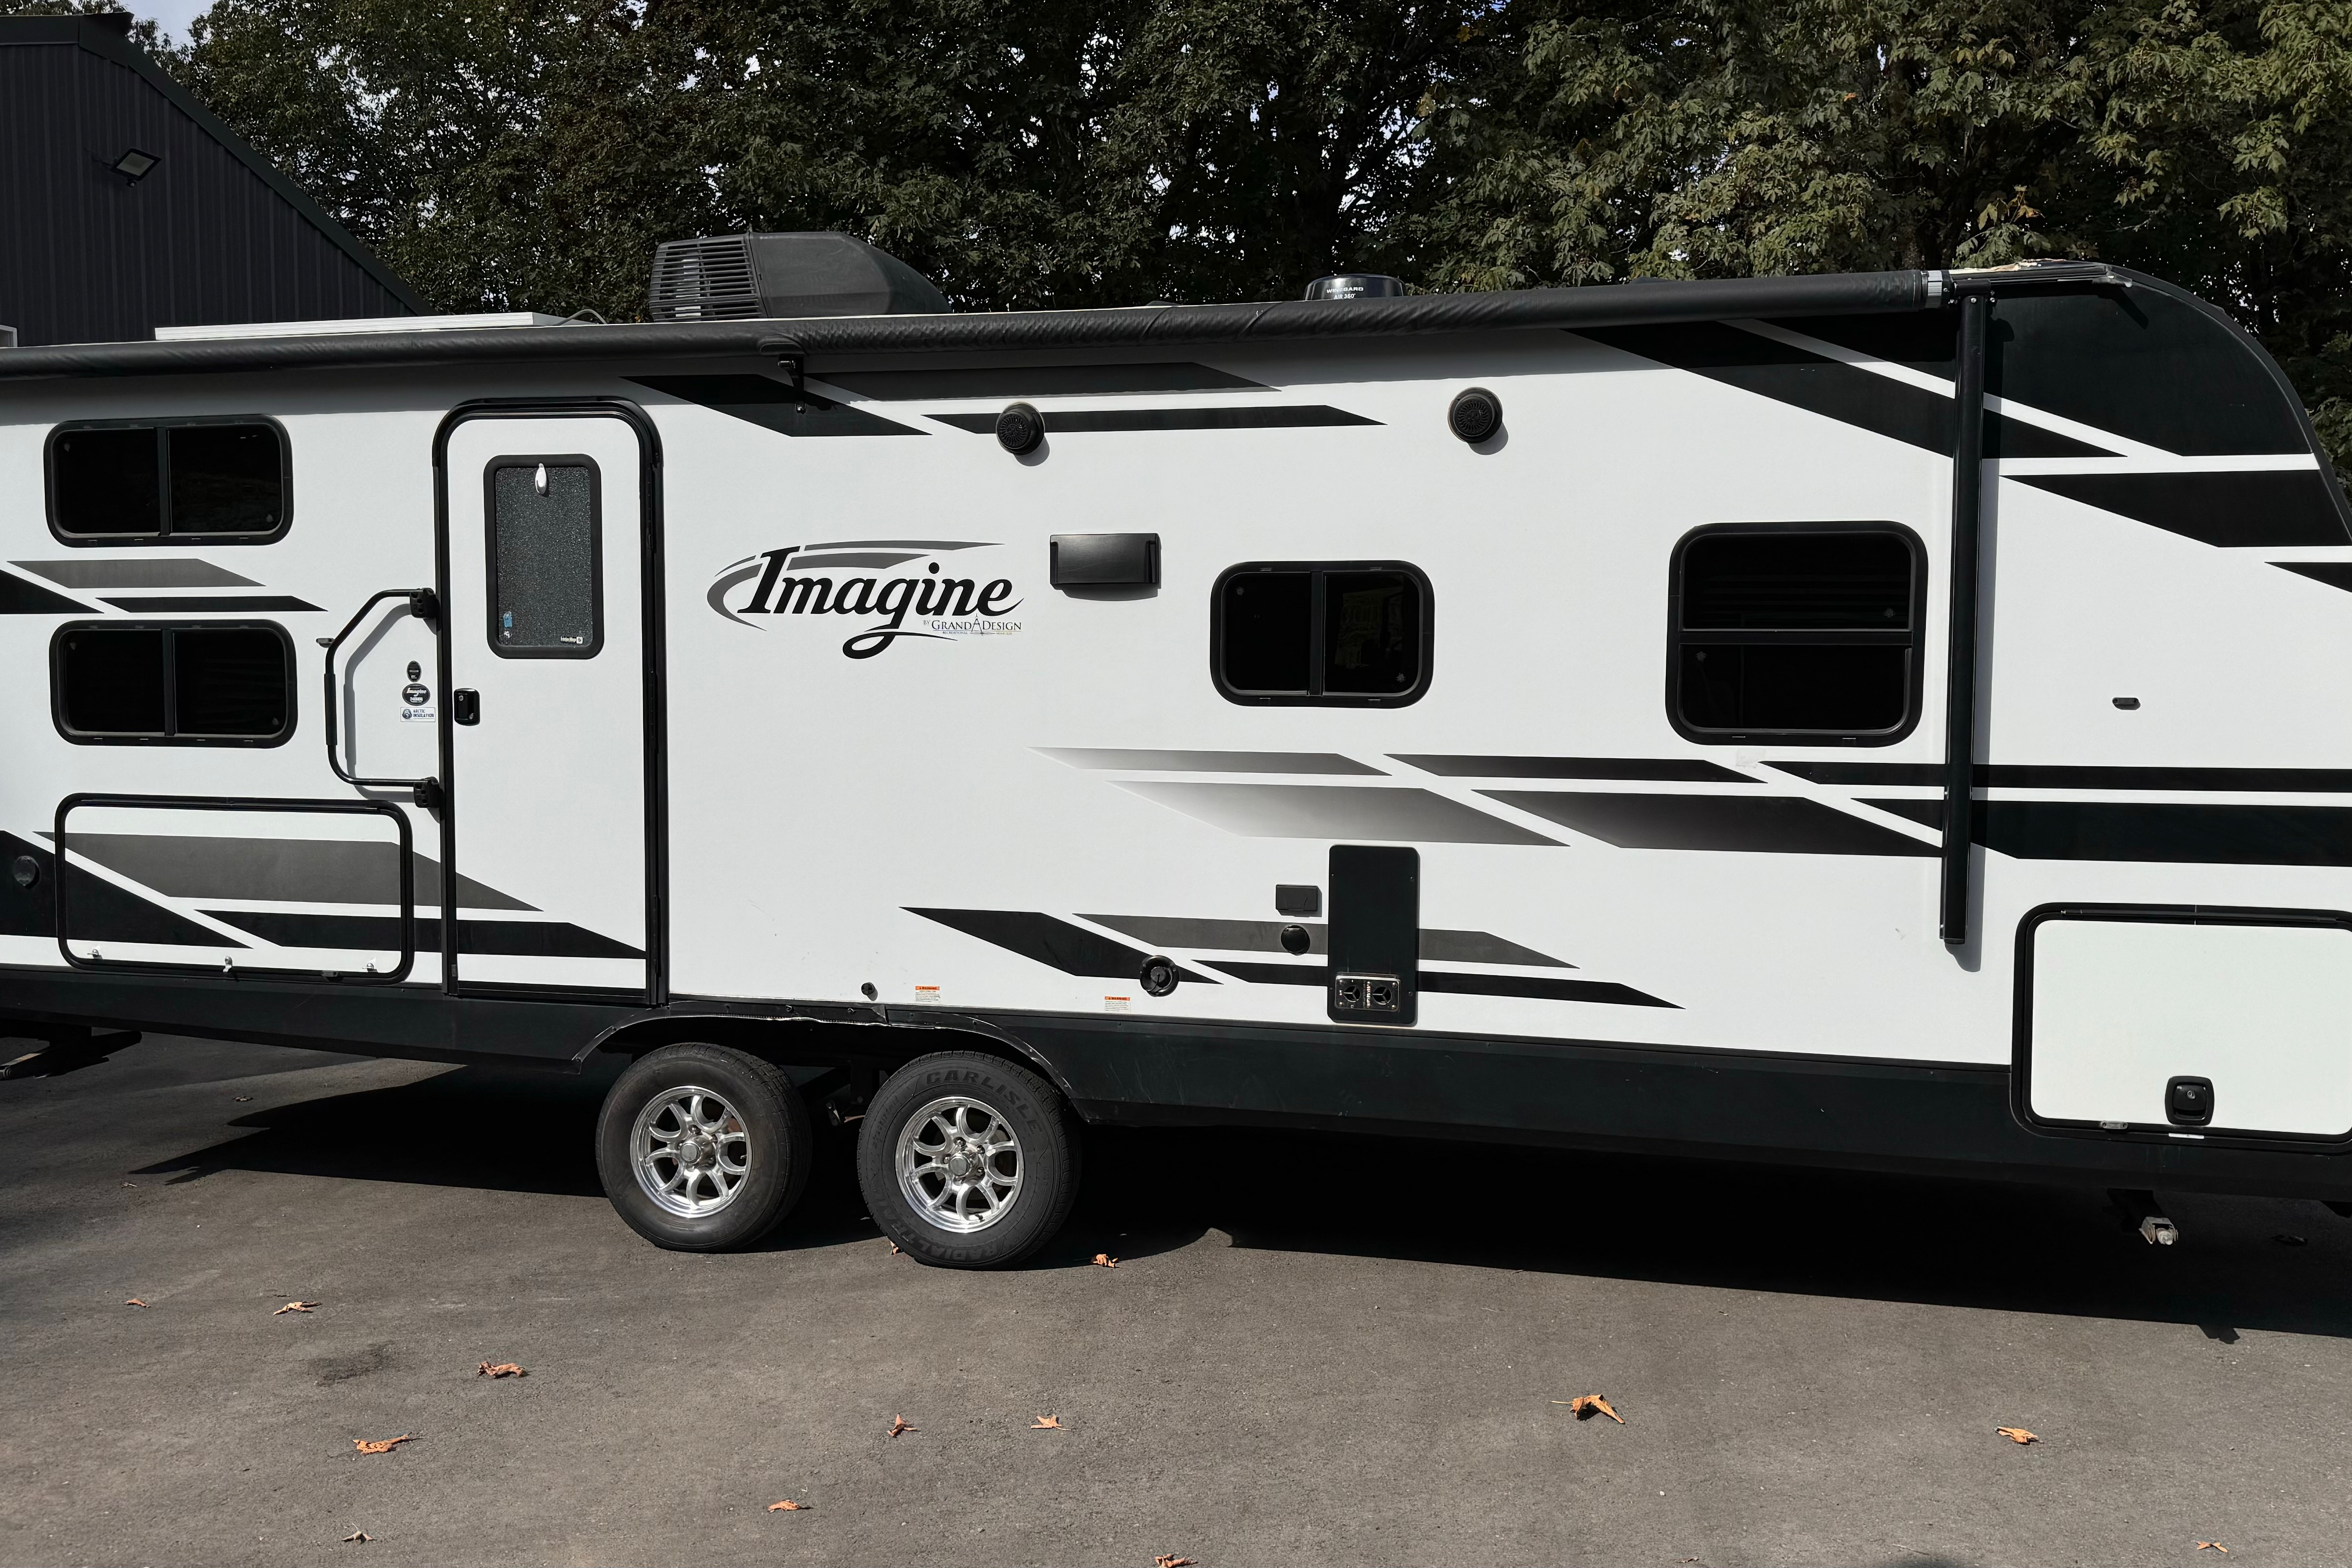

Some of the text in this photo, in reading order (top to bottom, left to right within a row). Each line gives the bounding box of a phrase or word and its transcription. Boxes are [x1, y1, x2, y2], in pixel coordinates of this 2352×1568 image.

[737, 545, 1024, 659] Imagine
[932, 620, 972, 630] GRAND
[982, 620, 1022, 631] DESIGN
[927, 1070, 1043, 1135] CARLISLE
